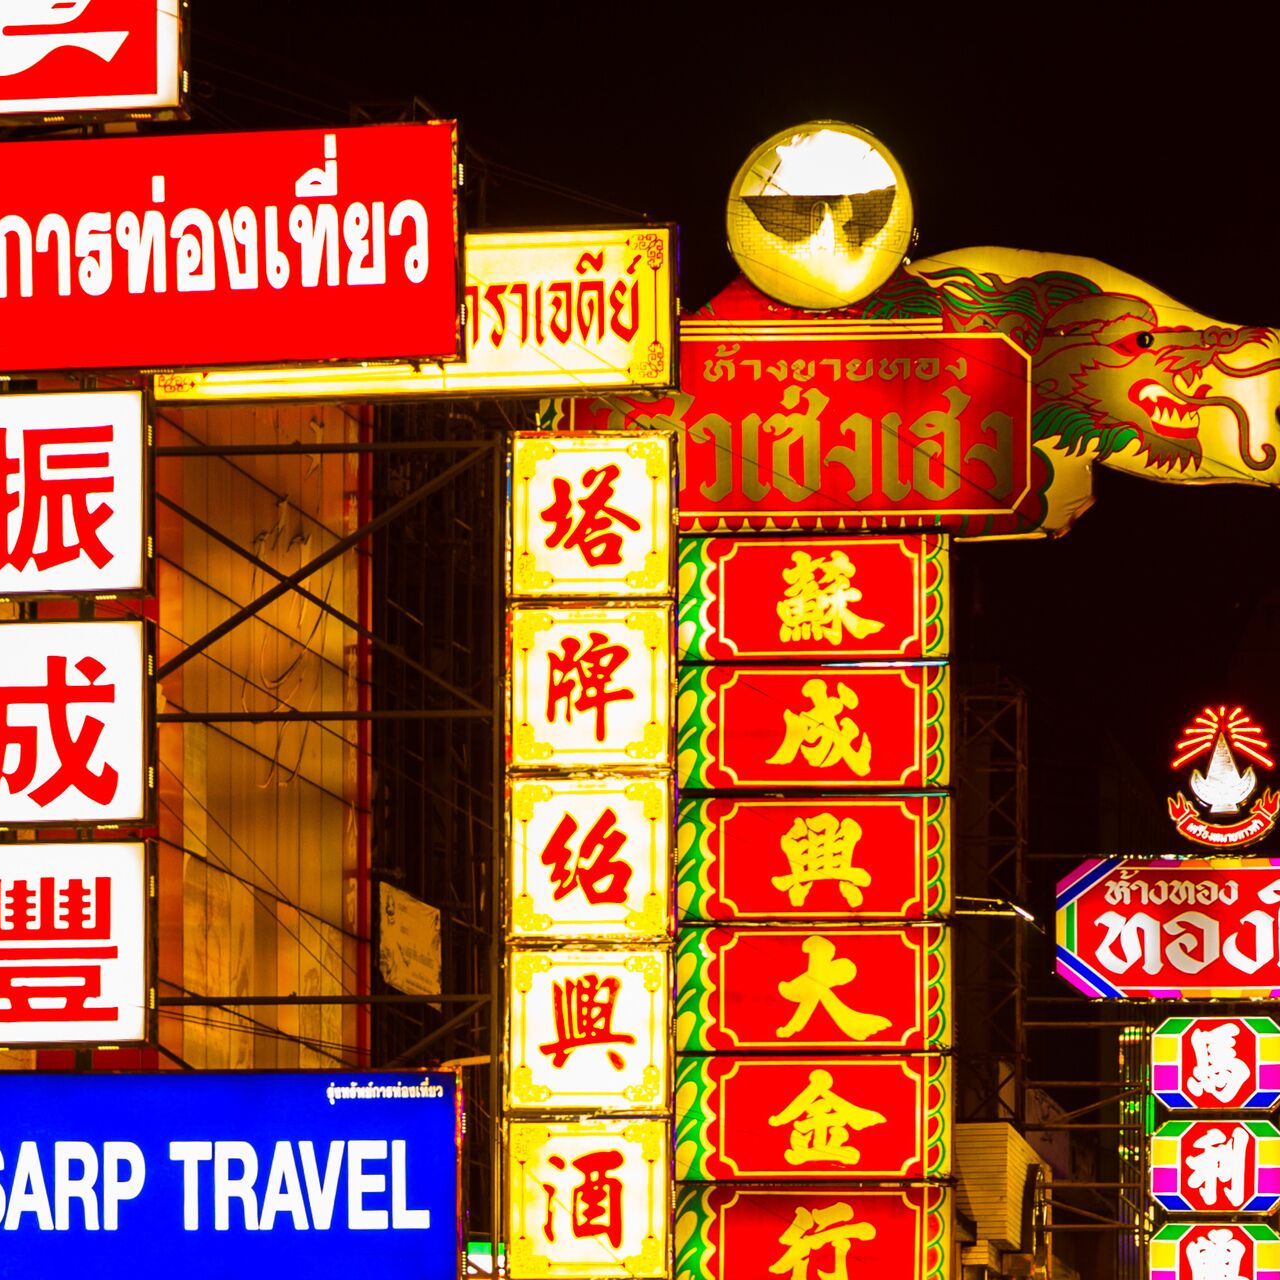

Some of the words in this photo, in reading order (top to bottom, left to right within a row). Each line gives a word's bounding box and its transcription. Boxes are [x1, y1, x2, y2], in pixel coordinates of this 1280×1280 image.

[703, 343, 968, 384] ห้างขายทอง
[539, 464, 636, 1249] 塔牌紹興酒
[1104, 870, 1239, 906] ห้างทอง
[327, 1077, 444, 1105] รุ่งทรัพย์การท่องเที่ยว
[169, 1139, 431, 1231] TRAVEL
